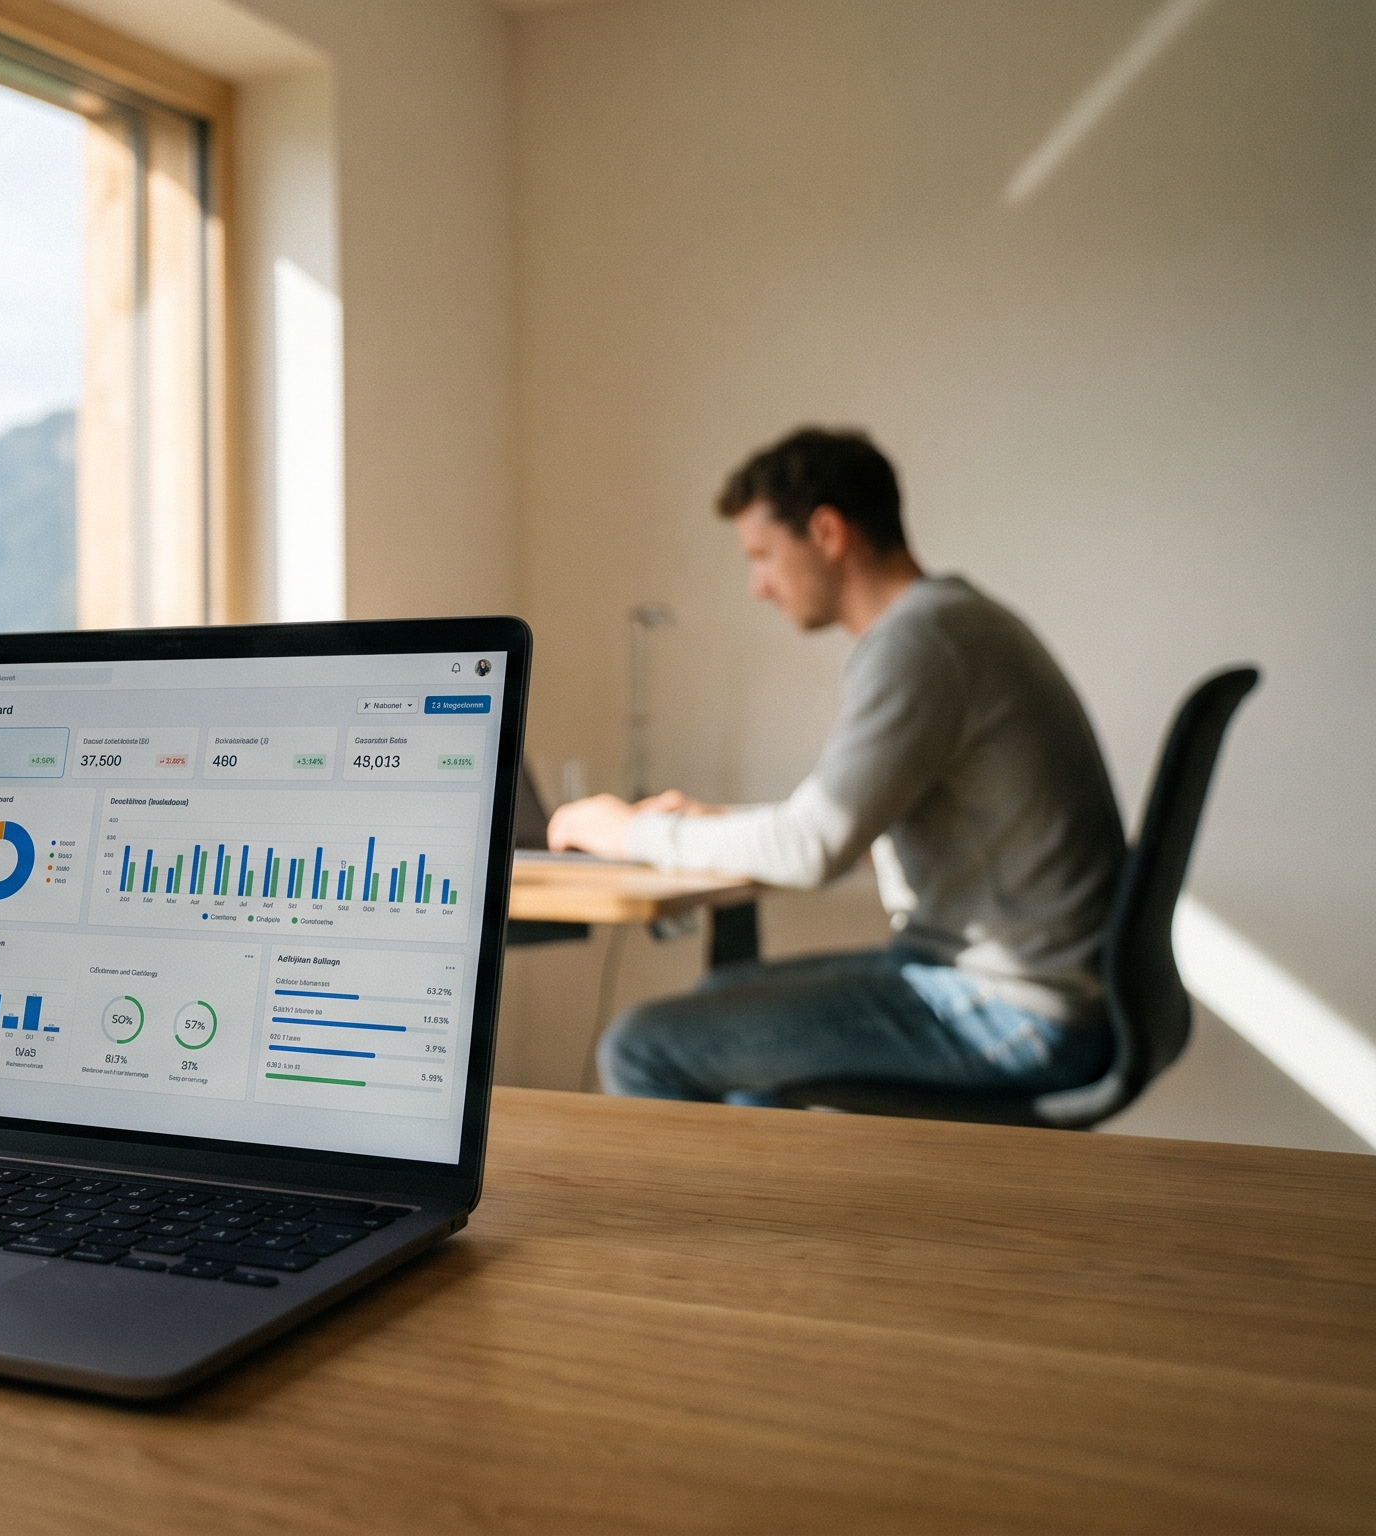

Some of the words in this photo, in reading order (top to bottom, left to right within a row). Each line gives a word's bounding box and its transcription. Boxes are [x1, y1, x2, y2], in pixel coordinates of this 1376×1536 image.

[80, 755, 122, 768] 37,500
[353, 755, 400, 770] 48,013
[111, 1014, 133, 1026] 50%
[184, 1019, 206, 1031] 57%
